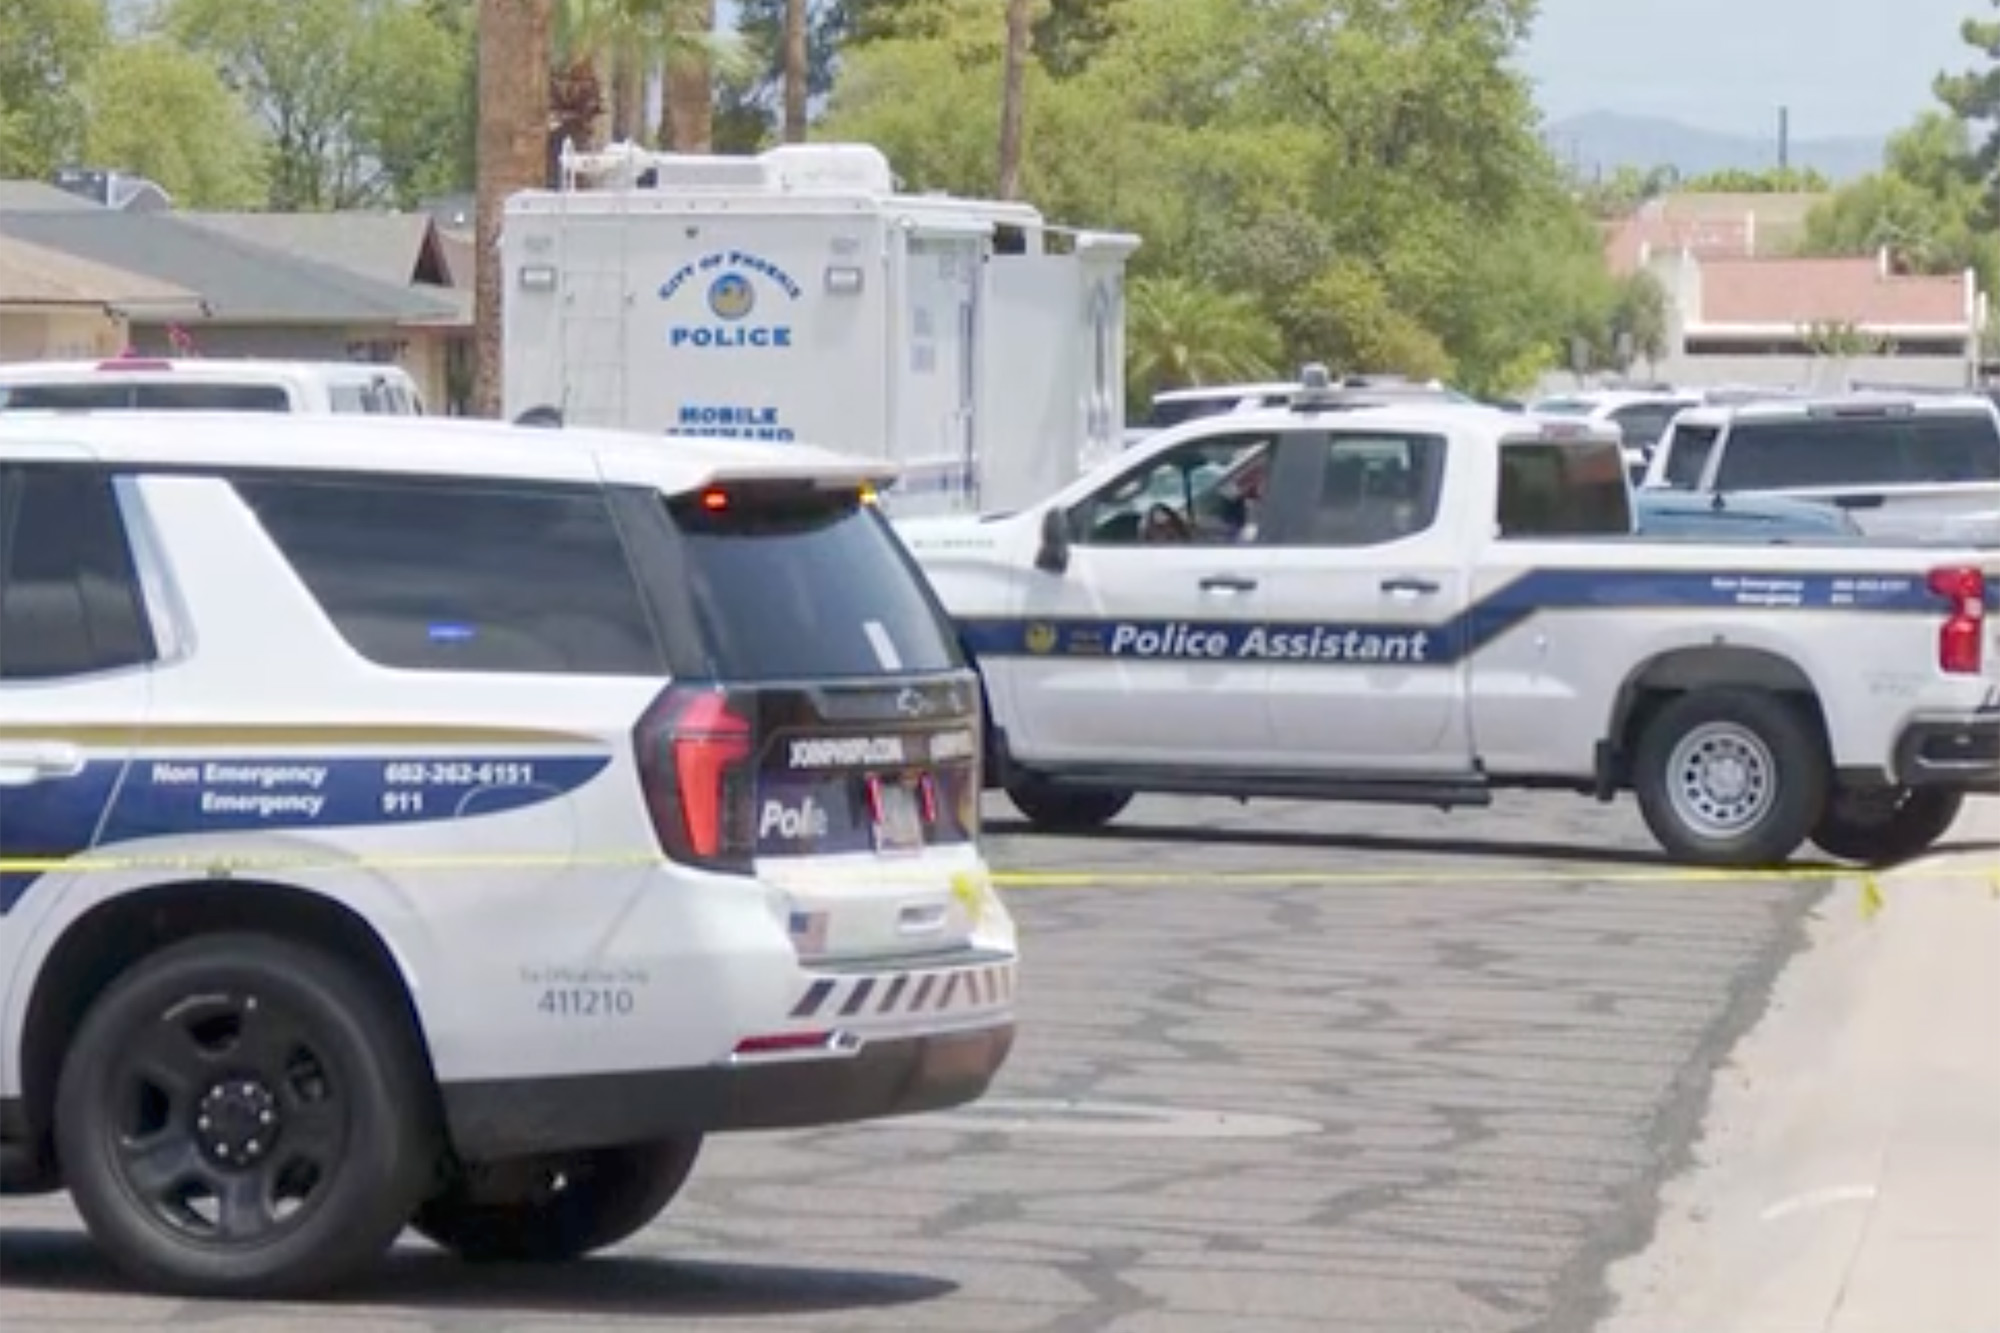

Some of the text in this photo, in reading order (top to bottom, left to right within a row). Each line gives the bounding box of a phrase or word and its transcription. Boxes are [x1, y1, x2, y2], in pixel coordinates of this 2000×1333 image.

[670, 327, 791, 347] POLICE
[679, 406, 778, 425] MOBILE
[1111, 621, 1228, 656] Police
[1238, 624, 1428, 661] Assistant
[151, 762, 198, 784] Non
[203, 762, 327, 788] Emergency
[201, 790, 424, 816] Emergency 911
[537, 989, 634, 1016] 411210
